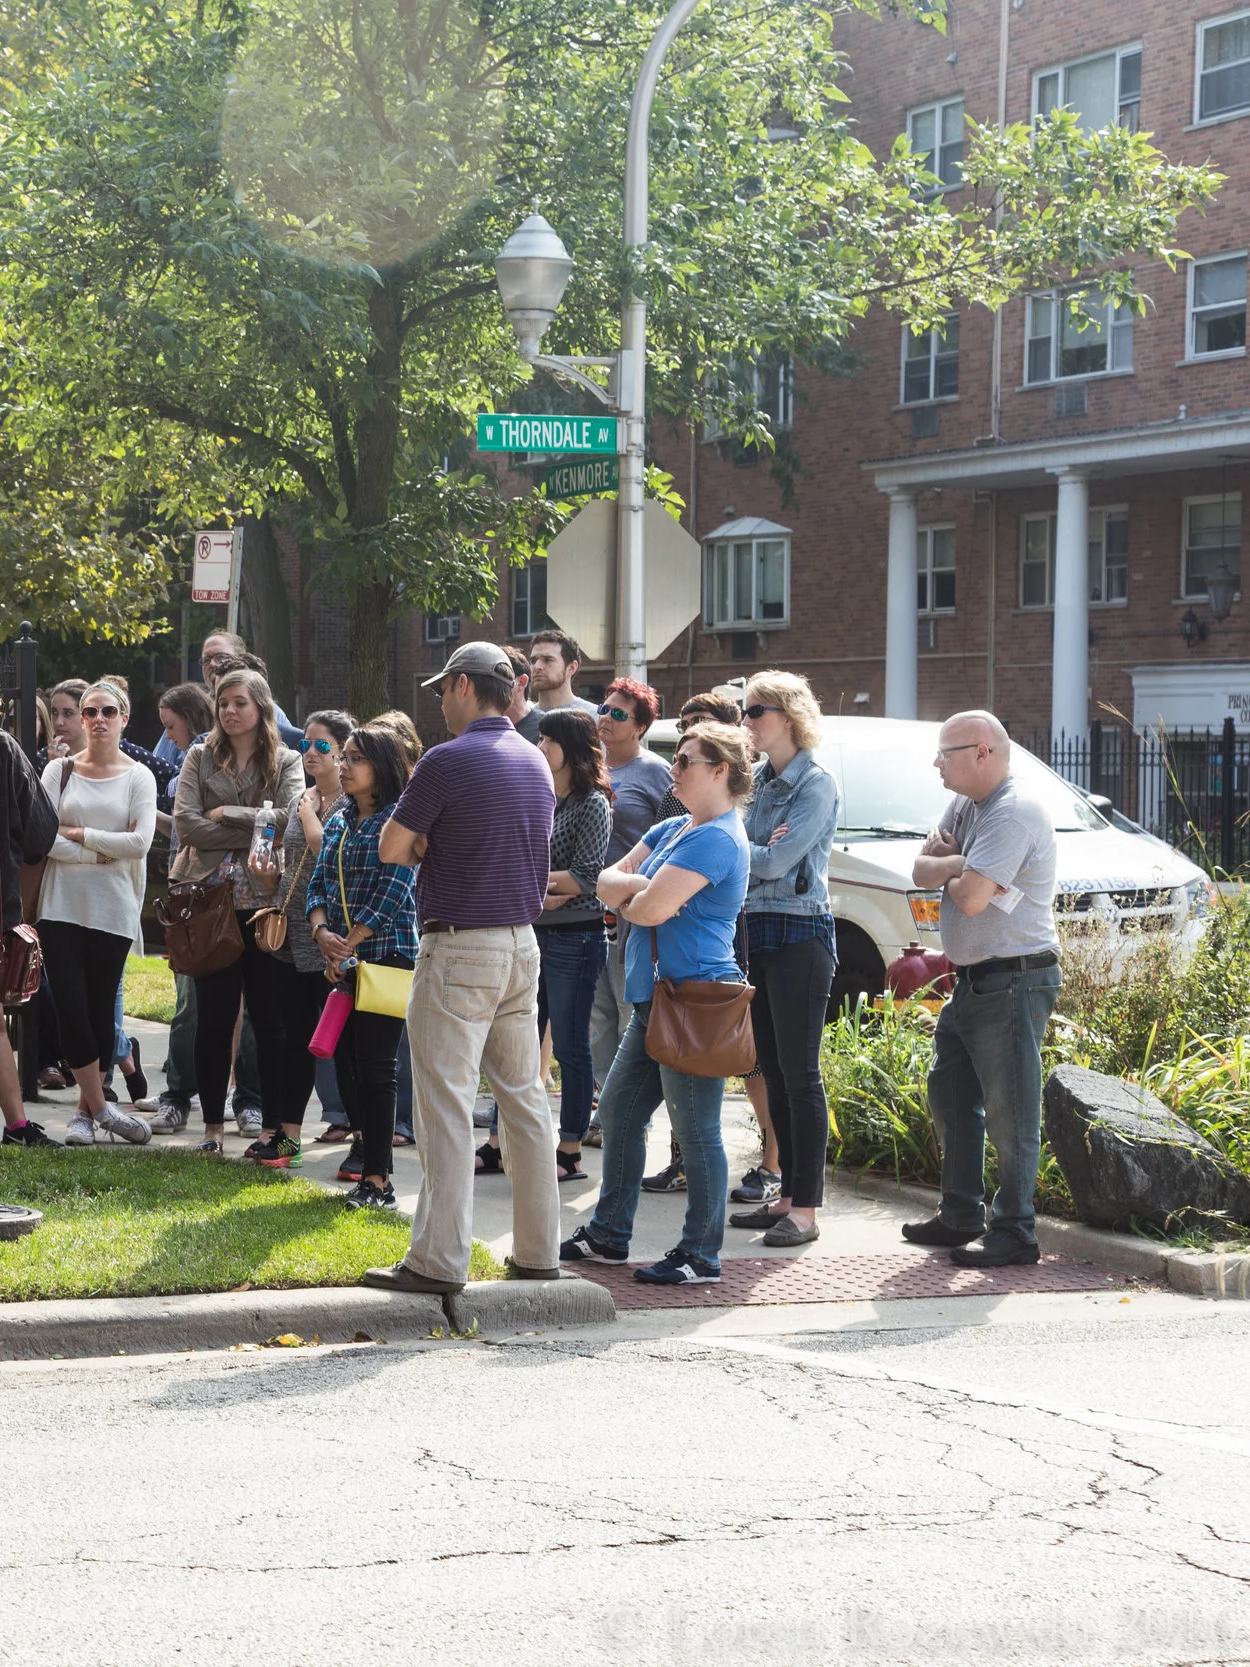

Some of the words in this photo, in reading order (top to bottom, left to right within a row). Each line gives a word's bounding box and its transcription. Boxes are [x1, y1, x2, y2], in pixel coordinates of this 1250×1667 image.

[485, 425, 494, 441] W
[499, 420, 592, 448] THORNDALE
[597, 428, 609, 443] AV
[555, 461, 610, 495] KENMORE
[194, 590, 208, 600] TOW
[210, 590, 227, 600] ZONE
